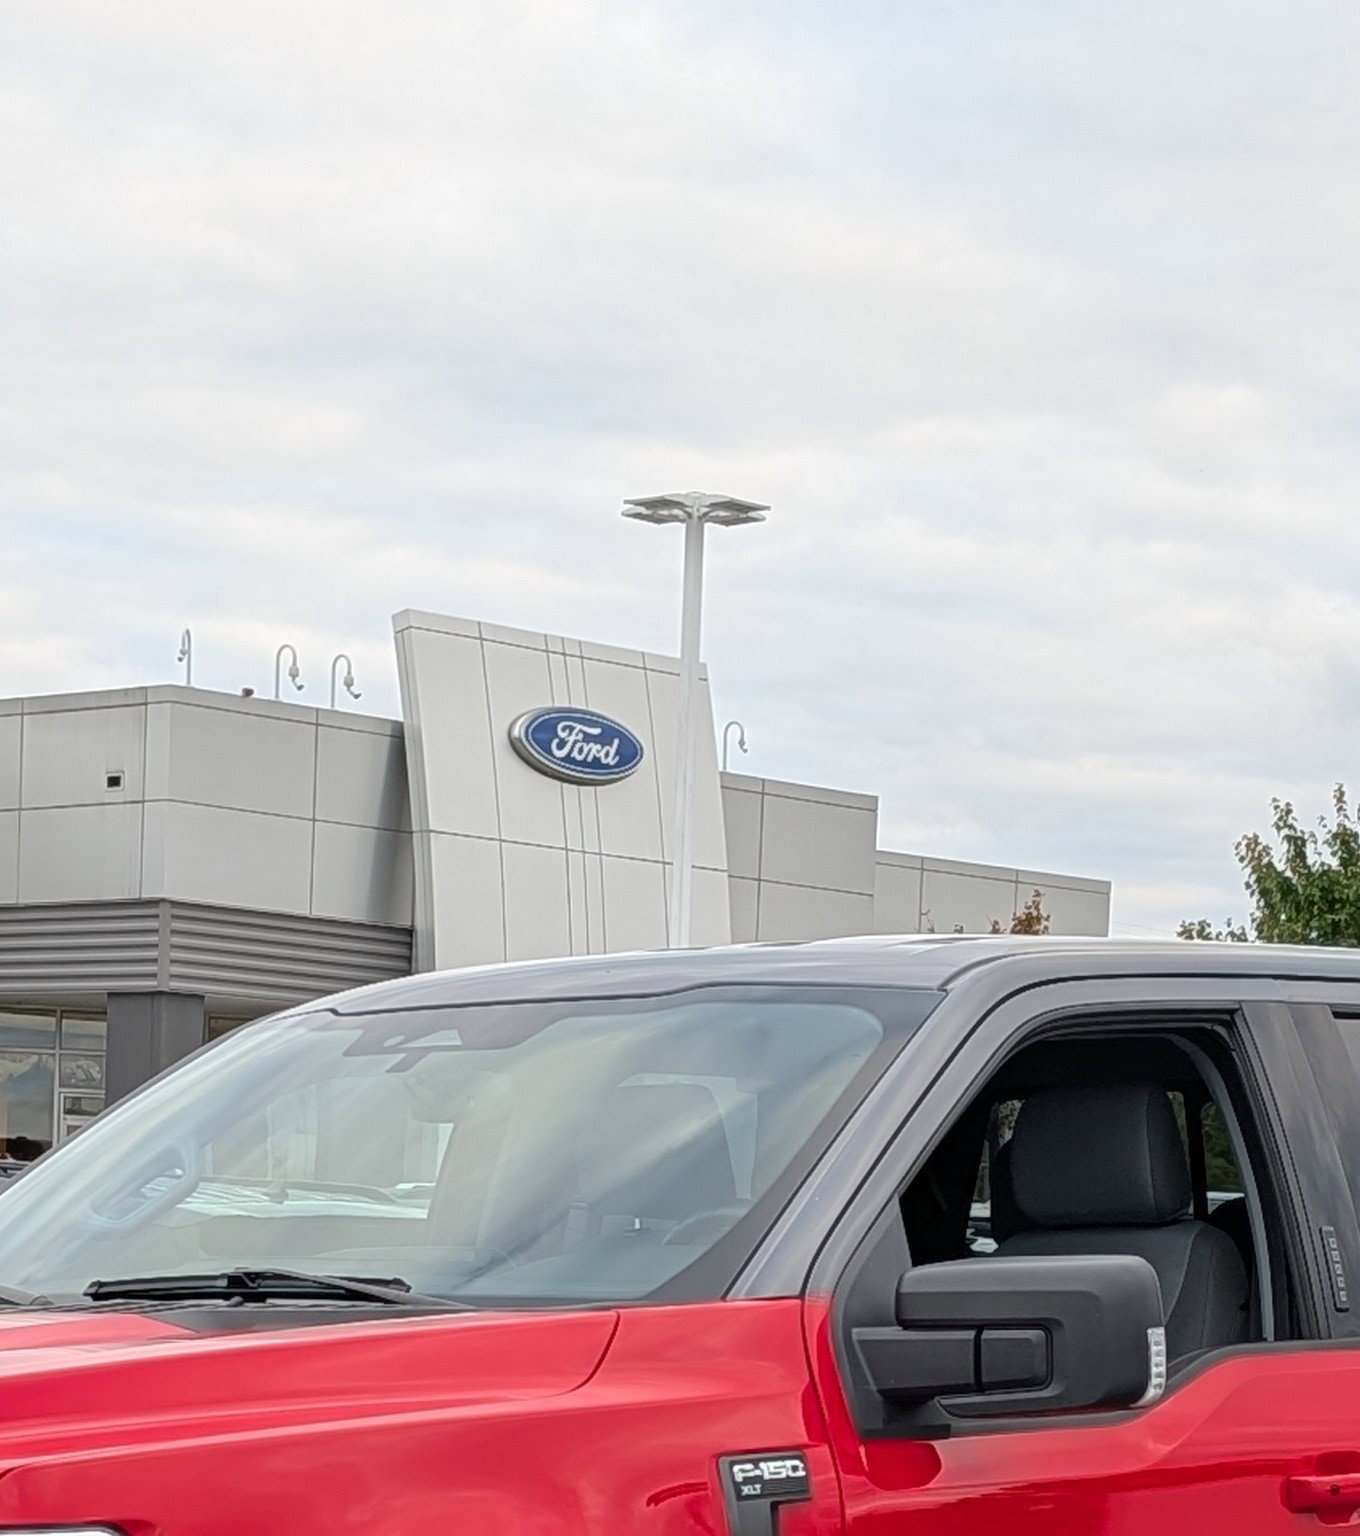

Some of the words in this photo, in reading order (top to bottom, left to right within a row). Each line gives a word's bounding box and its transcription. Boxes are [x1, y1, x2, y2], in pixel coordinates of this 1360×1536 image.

[550, 720, 620, 766] Ford
[732, 1459, 807, 1483] F-150
[741, 1483, 762, 1496] XLT
